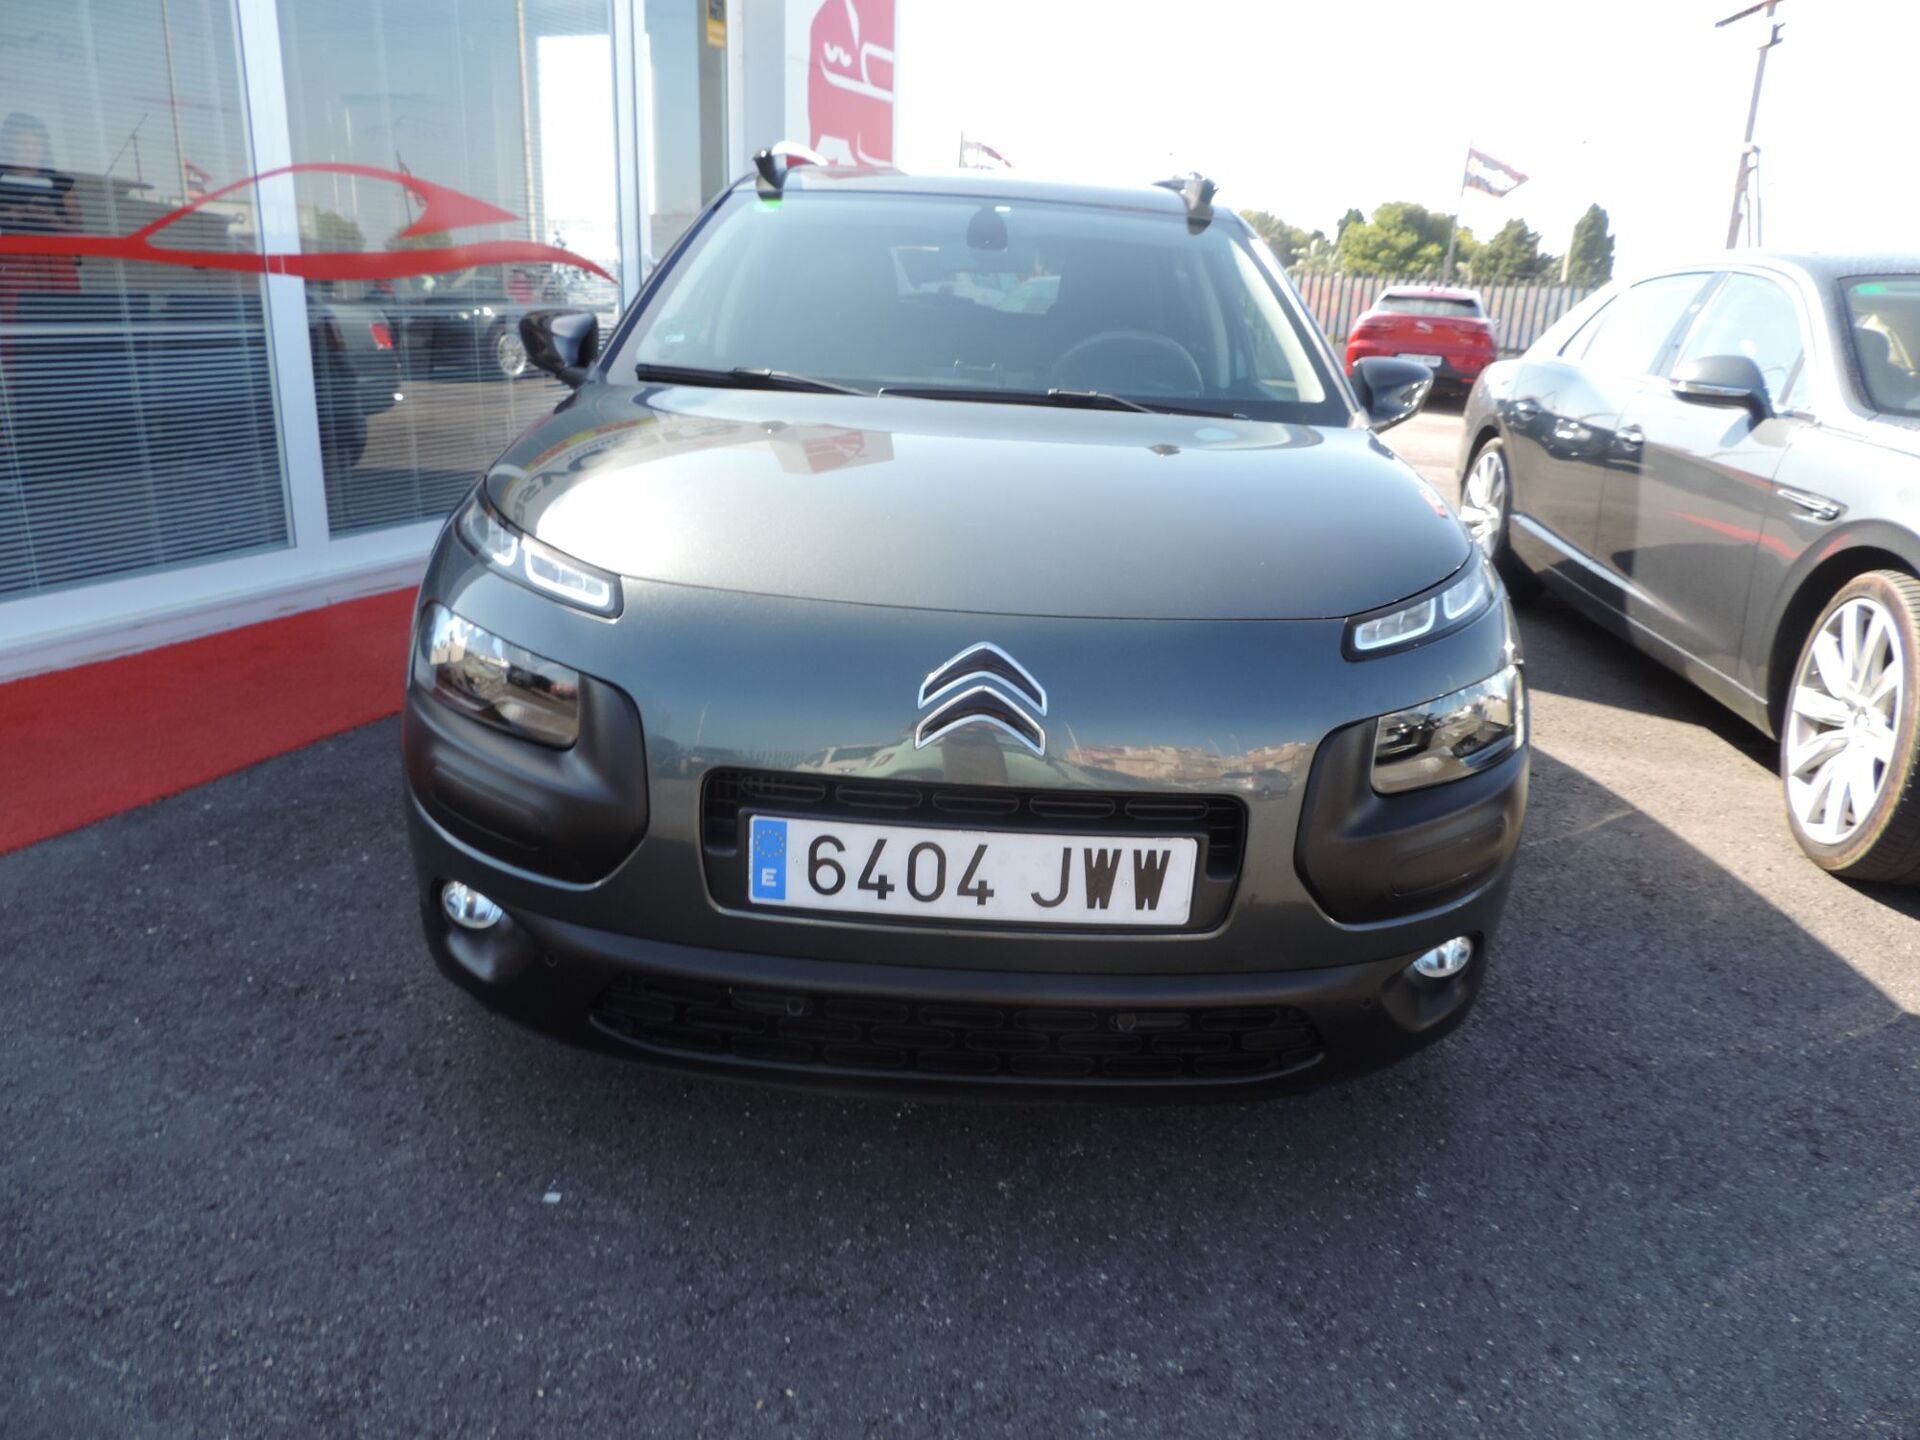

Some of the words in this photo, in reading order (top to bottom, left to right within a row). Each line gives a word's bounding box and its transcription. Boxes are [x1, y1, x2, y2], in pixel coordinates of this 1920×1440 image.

[761, 868, 777, 887] E
[806, 834, 995, 906] 6404
[1030, 847, 1172, 910] JWW
